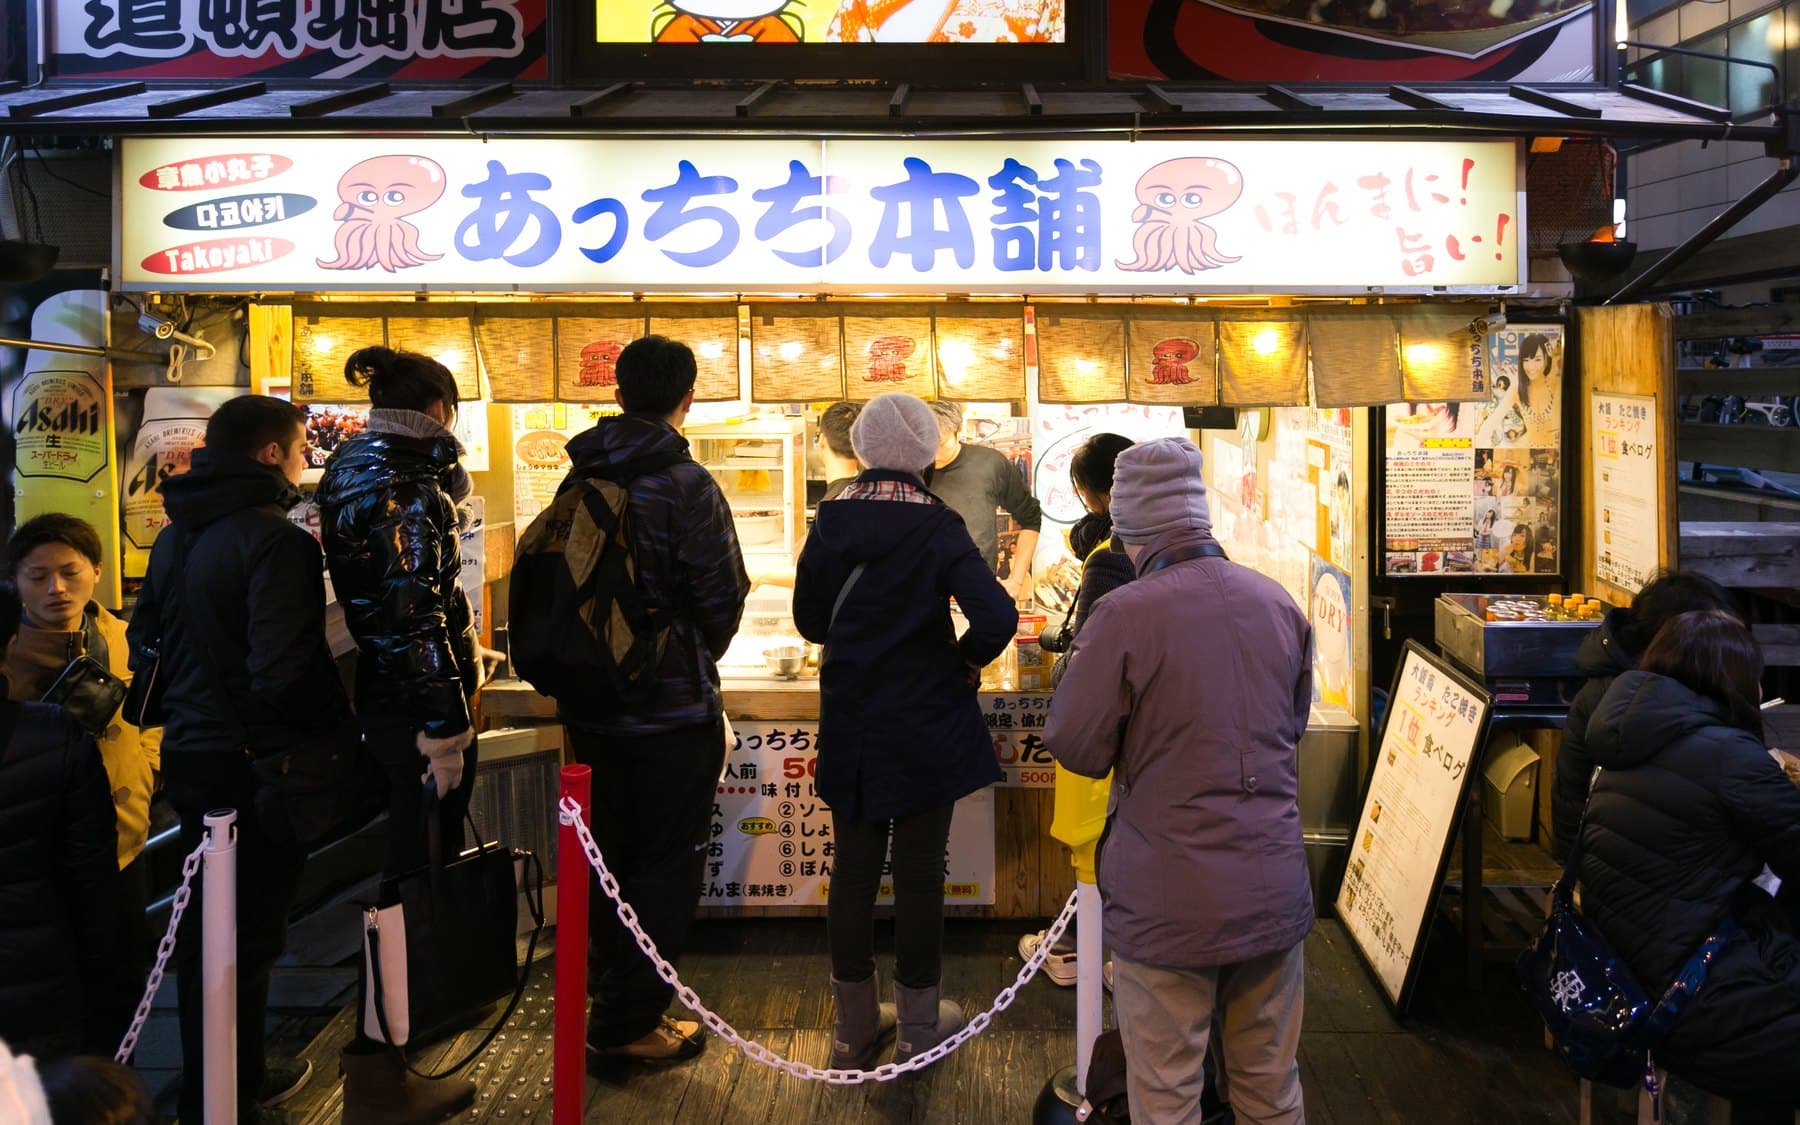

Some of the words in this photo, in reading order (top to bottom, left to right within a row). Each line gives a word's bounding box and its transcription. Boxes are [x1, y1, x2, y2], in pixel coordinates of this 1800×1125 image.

[453, 156, 1103, 273] あっちち本舗
[165, 239, 274, 273] Takoyaki
[17, 399, 99, 436] Asahi
[46, 434, 62, 448] 生
[31, 450, 79, 462] スーパードライ
[740, 821, 774, 831] おすすめ
